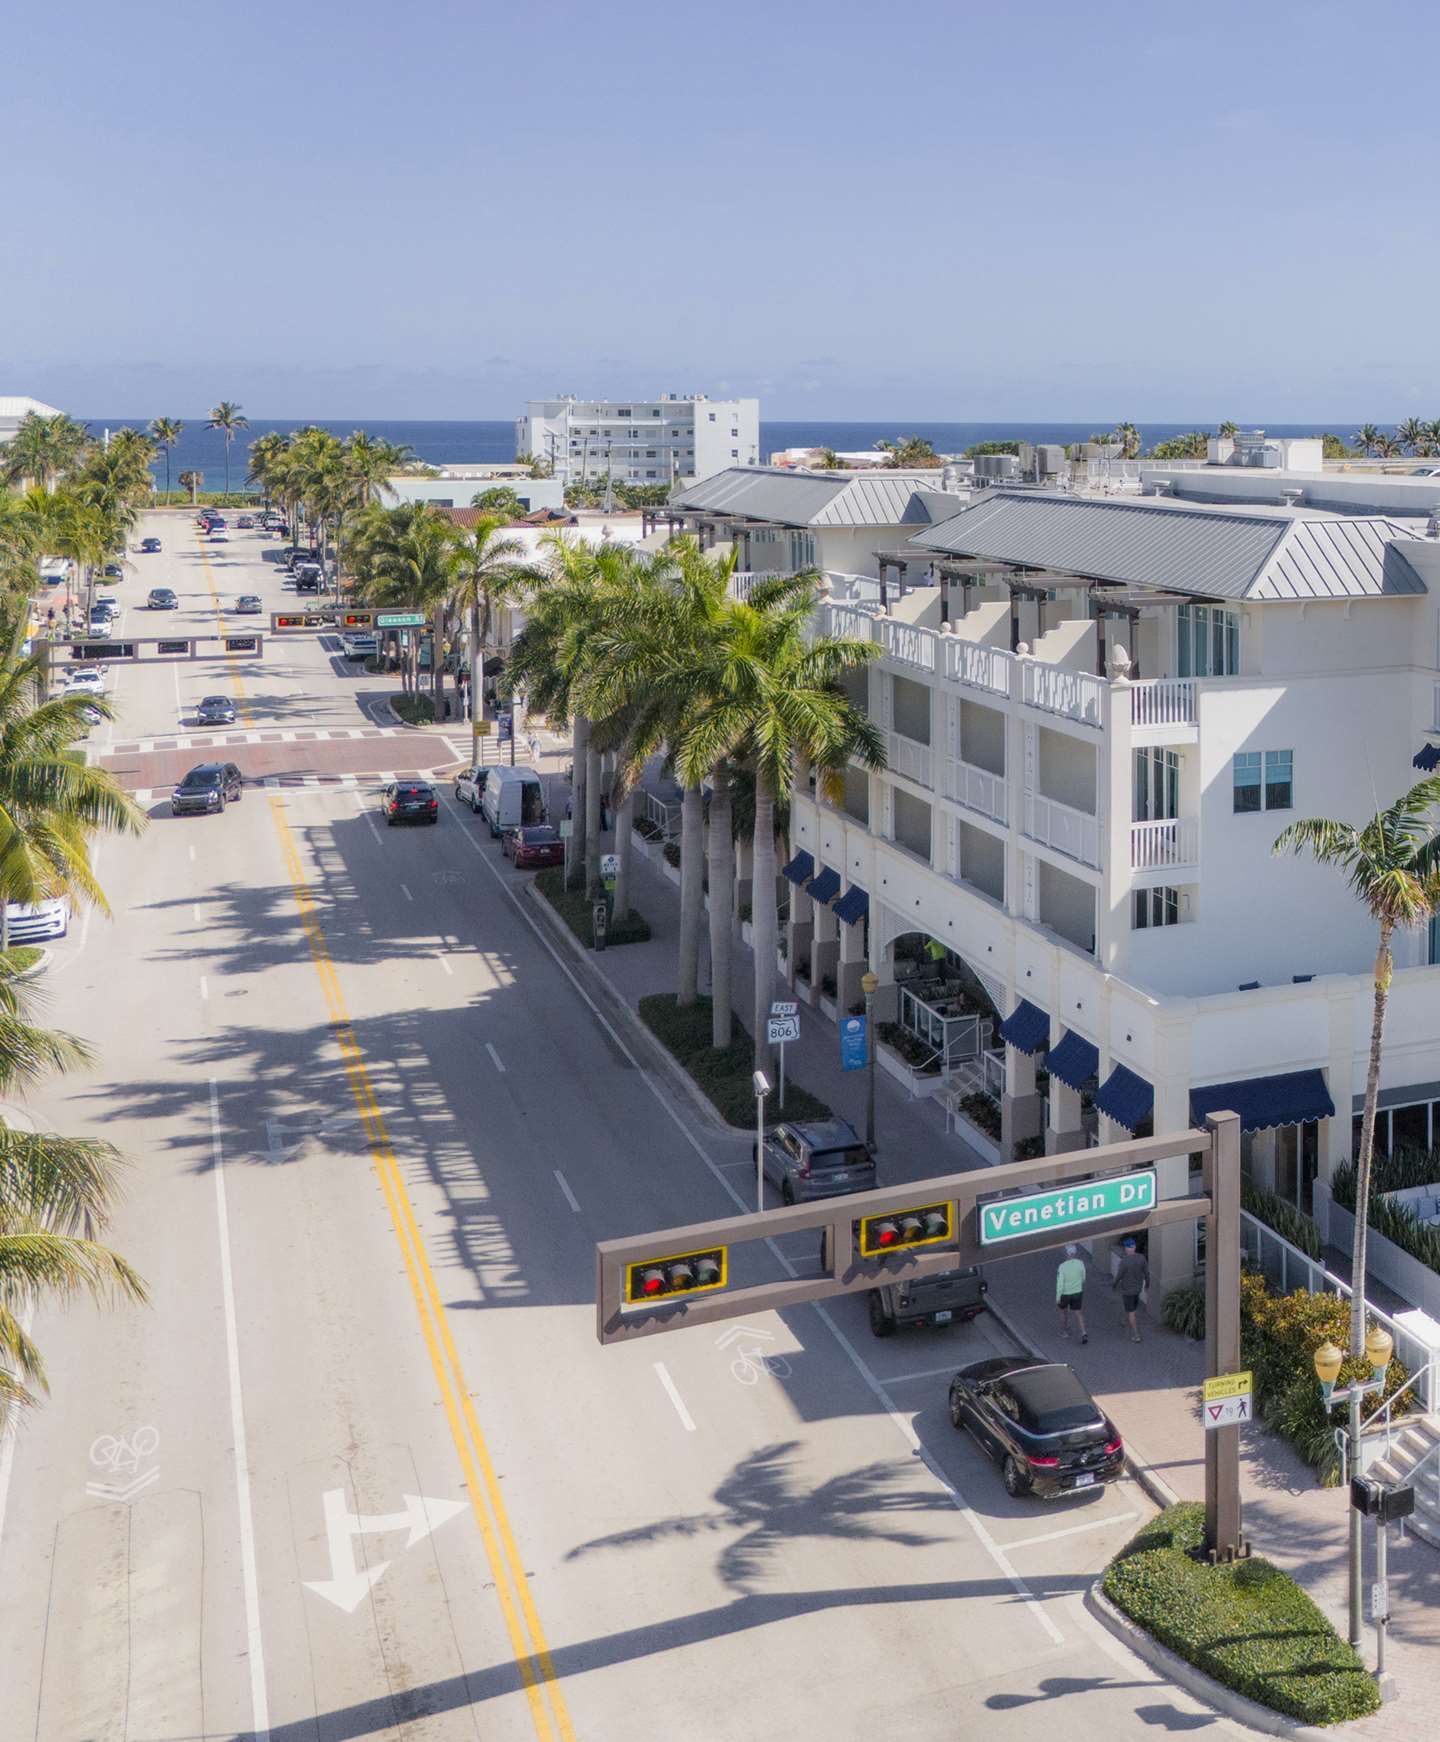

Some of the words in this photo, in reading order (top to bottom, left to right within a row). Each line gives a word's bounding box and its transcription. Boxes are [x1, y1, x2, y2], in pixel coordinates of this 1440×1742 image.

[775, 1004, 793, 1012] EAST
[770, 1027, 792, 1039] 806
[990, 1193, 1105, 1231] Venetian
[1120, 1183, 1148, 1203] Dr
[1208, 1379, 1235, 1389] TURNING
[1207, 1387, 1236, 1398] VEHICLES
